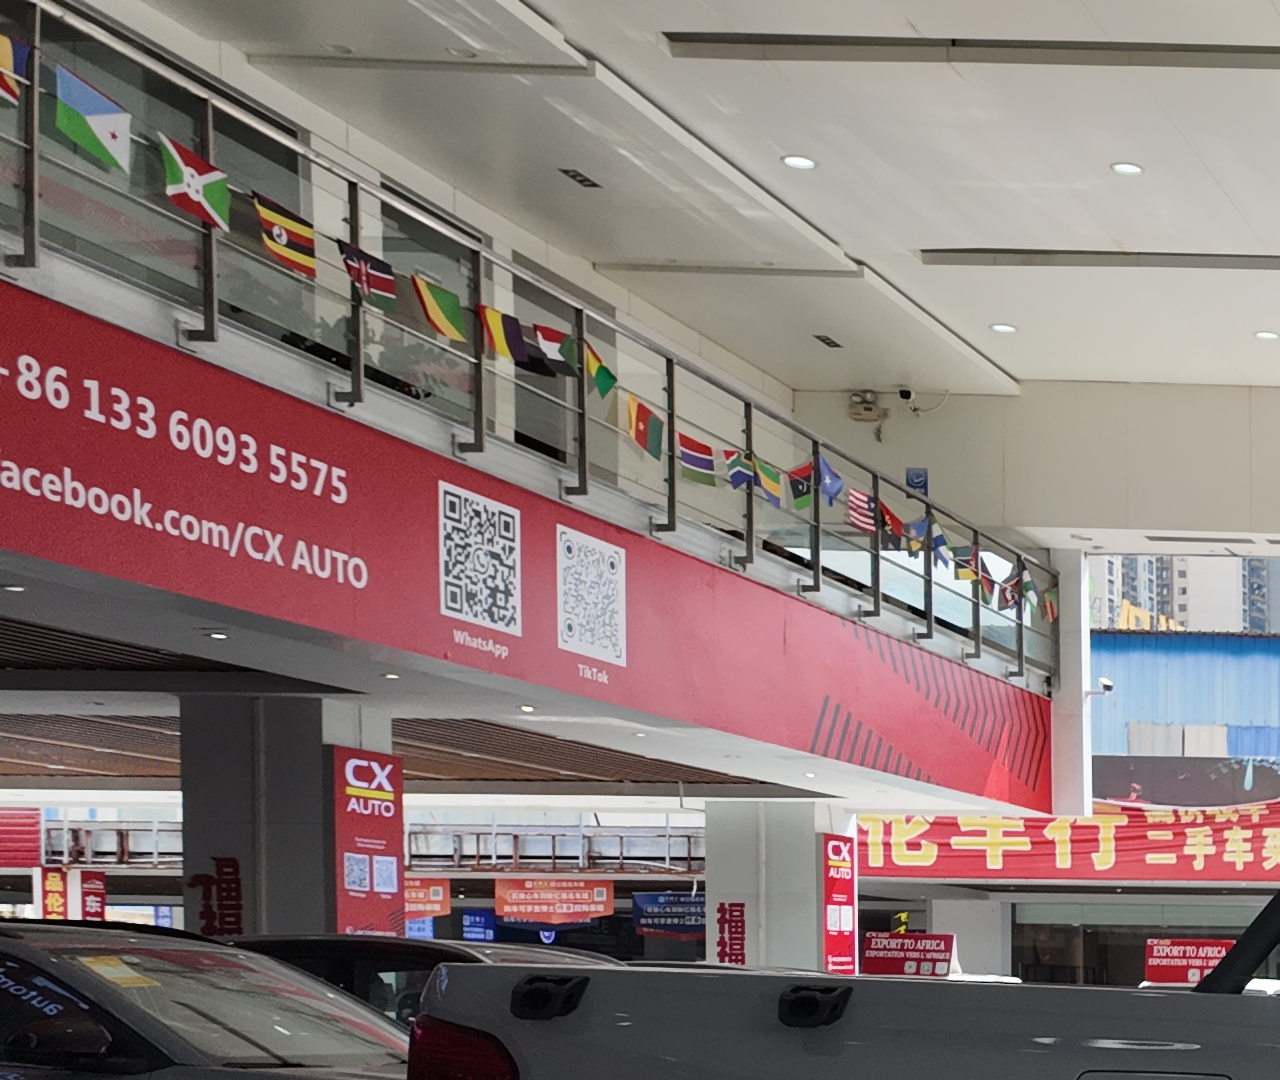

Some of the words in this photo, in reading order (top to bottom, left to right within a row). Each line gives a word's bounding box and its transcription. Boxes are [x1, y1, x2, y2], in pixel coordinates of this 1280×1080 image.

[82, 380, 158, 440] 133
[169, 410, 259, 473] 6093
[269, 444, 348, 504] 5575
[0, 460, 286, 567] acebook.com/CX
[291, 540, 369, 589] AUTO
[453, 629, 509, 659] WhatsApp
[578, 664, 609, 684] TikTok
[345, 758, 393, 791] CX
[347, 797, 394, 817] AUTO
[828, 840, 851, 861] CX
[829, 867, 851, 879] AUTO
[871, 938, 902, 949] EXPORT
[904, 939, 915, 950] TO
[916, 940, 945, 951] AFRICA
[1153, 946, 1184, 957] EXPORT
[1185, 946, 1197, 957] TO
[1197, 946, 1226, 957] AFRICA
